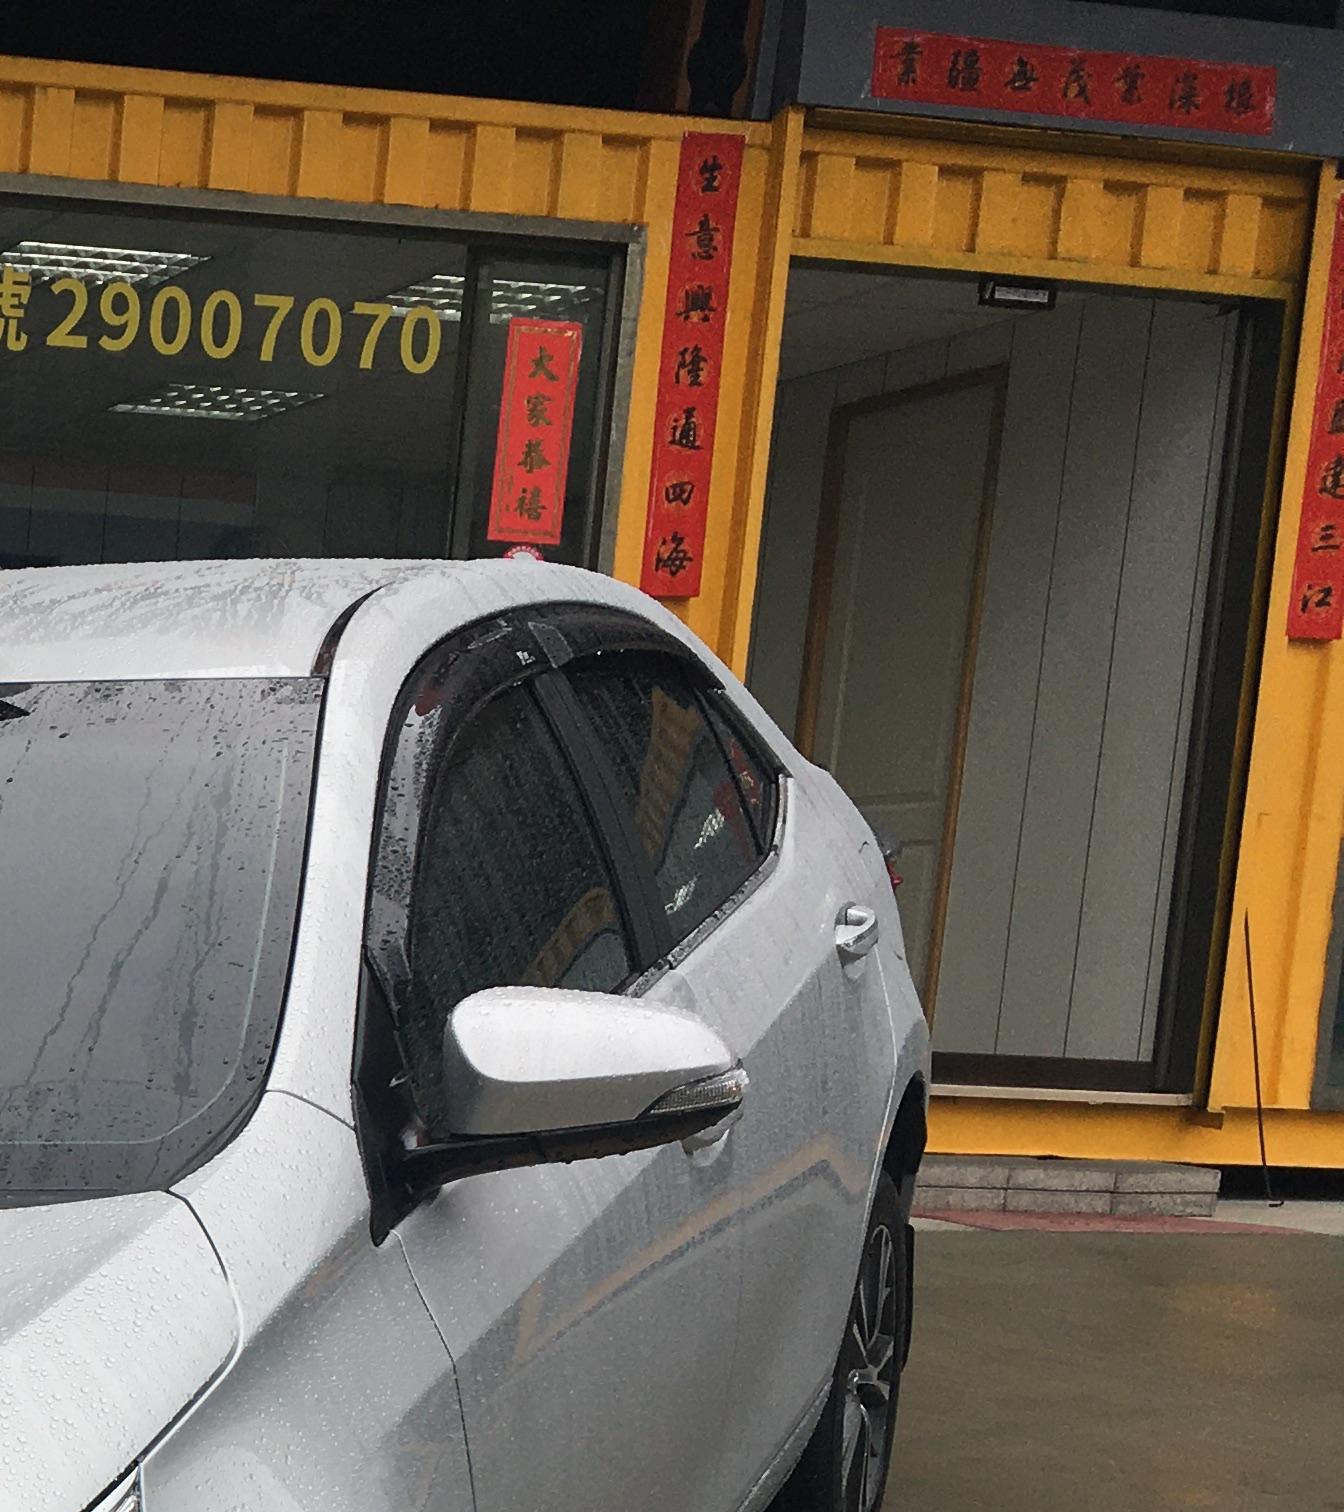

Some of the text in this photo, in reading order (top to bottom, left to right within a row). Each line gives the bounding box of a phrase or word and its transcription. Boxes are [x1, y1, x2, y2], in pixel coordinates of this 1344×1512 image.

[46, 278, 442, 374] 29007070
[653, 155, 723, 578] 生意興隆通四海
